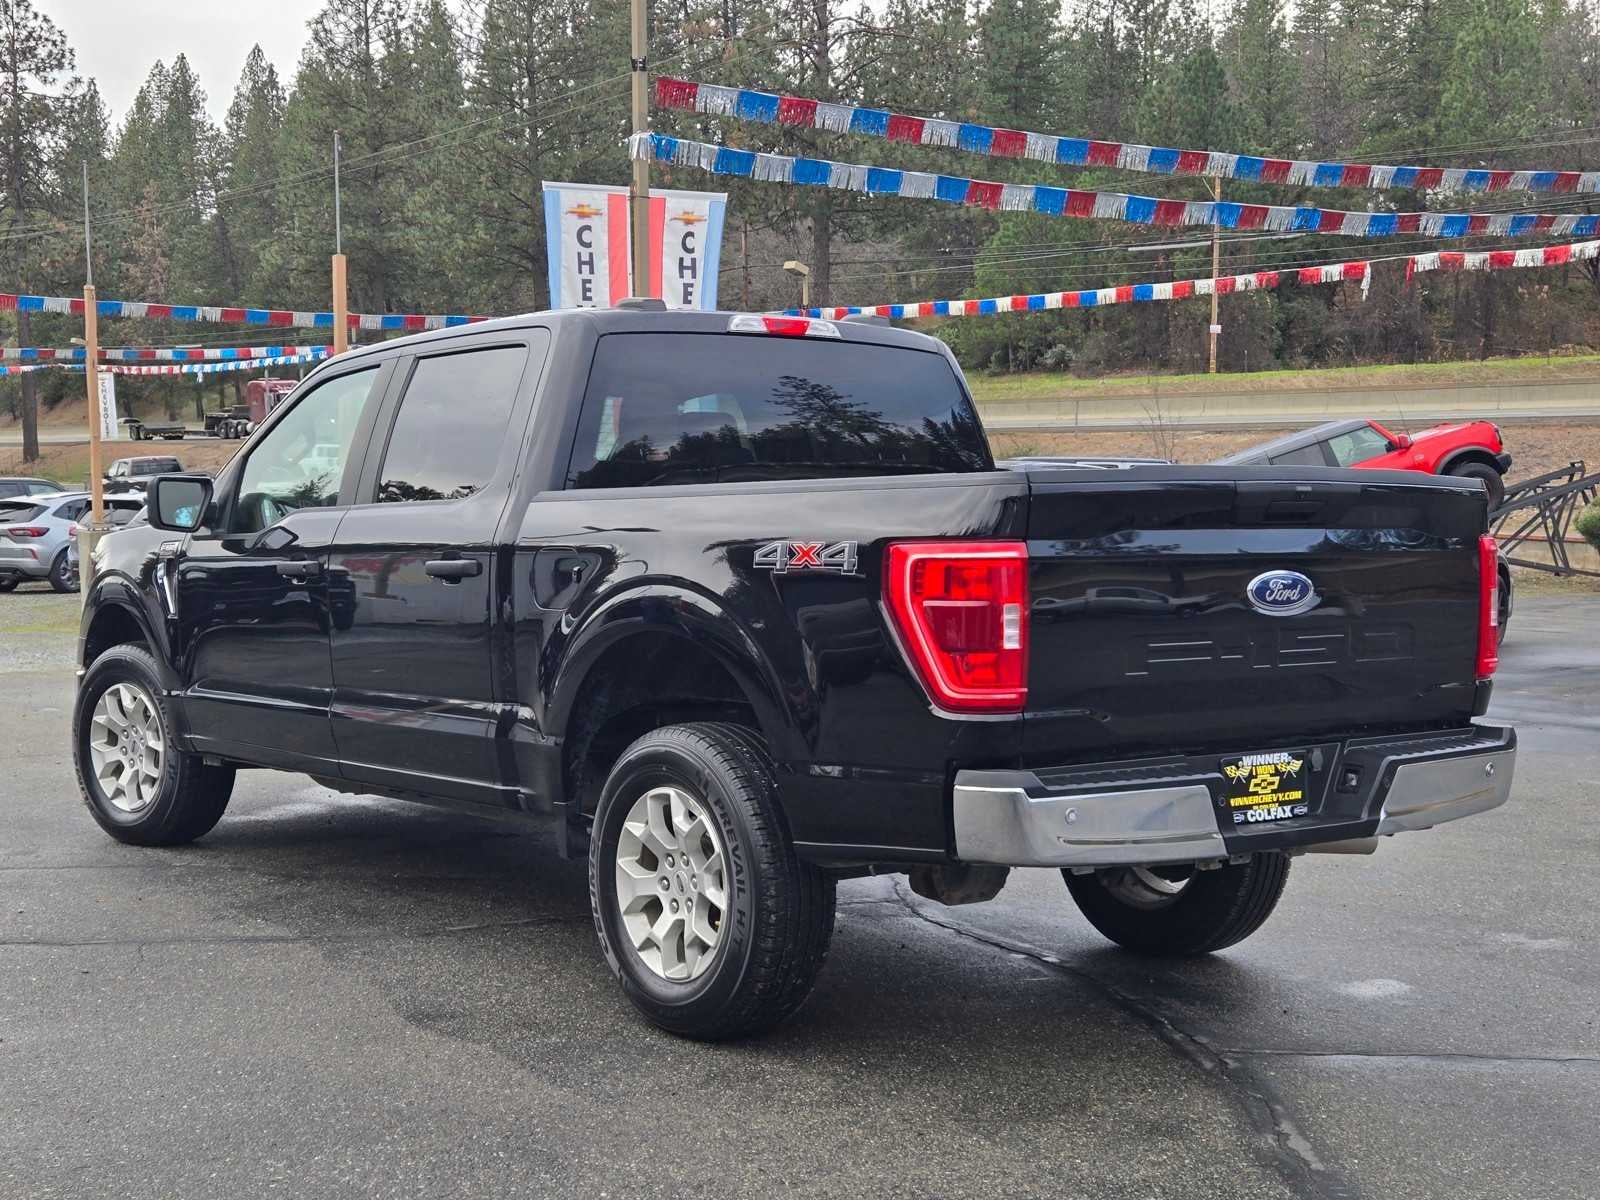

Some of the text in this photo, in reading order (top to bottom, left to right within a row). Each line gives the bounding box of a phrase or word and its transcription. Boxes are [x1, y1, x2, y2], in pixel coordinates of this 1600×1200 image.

[576, 225, 595, 307] CHE
[1265, 579, 1301, 602] Ford
[1242, 752, 1289, 766] WINNER
[1247, 806, 1293, 822] COLFAX
[713, 799, 747, 899] PREVAIL
